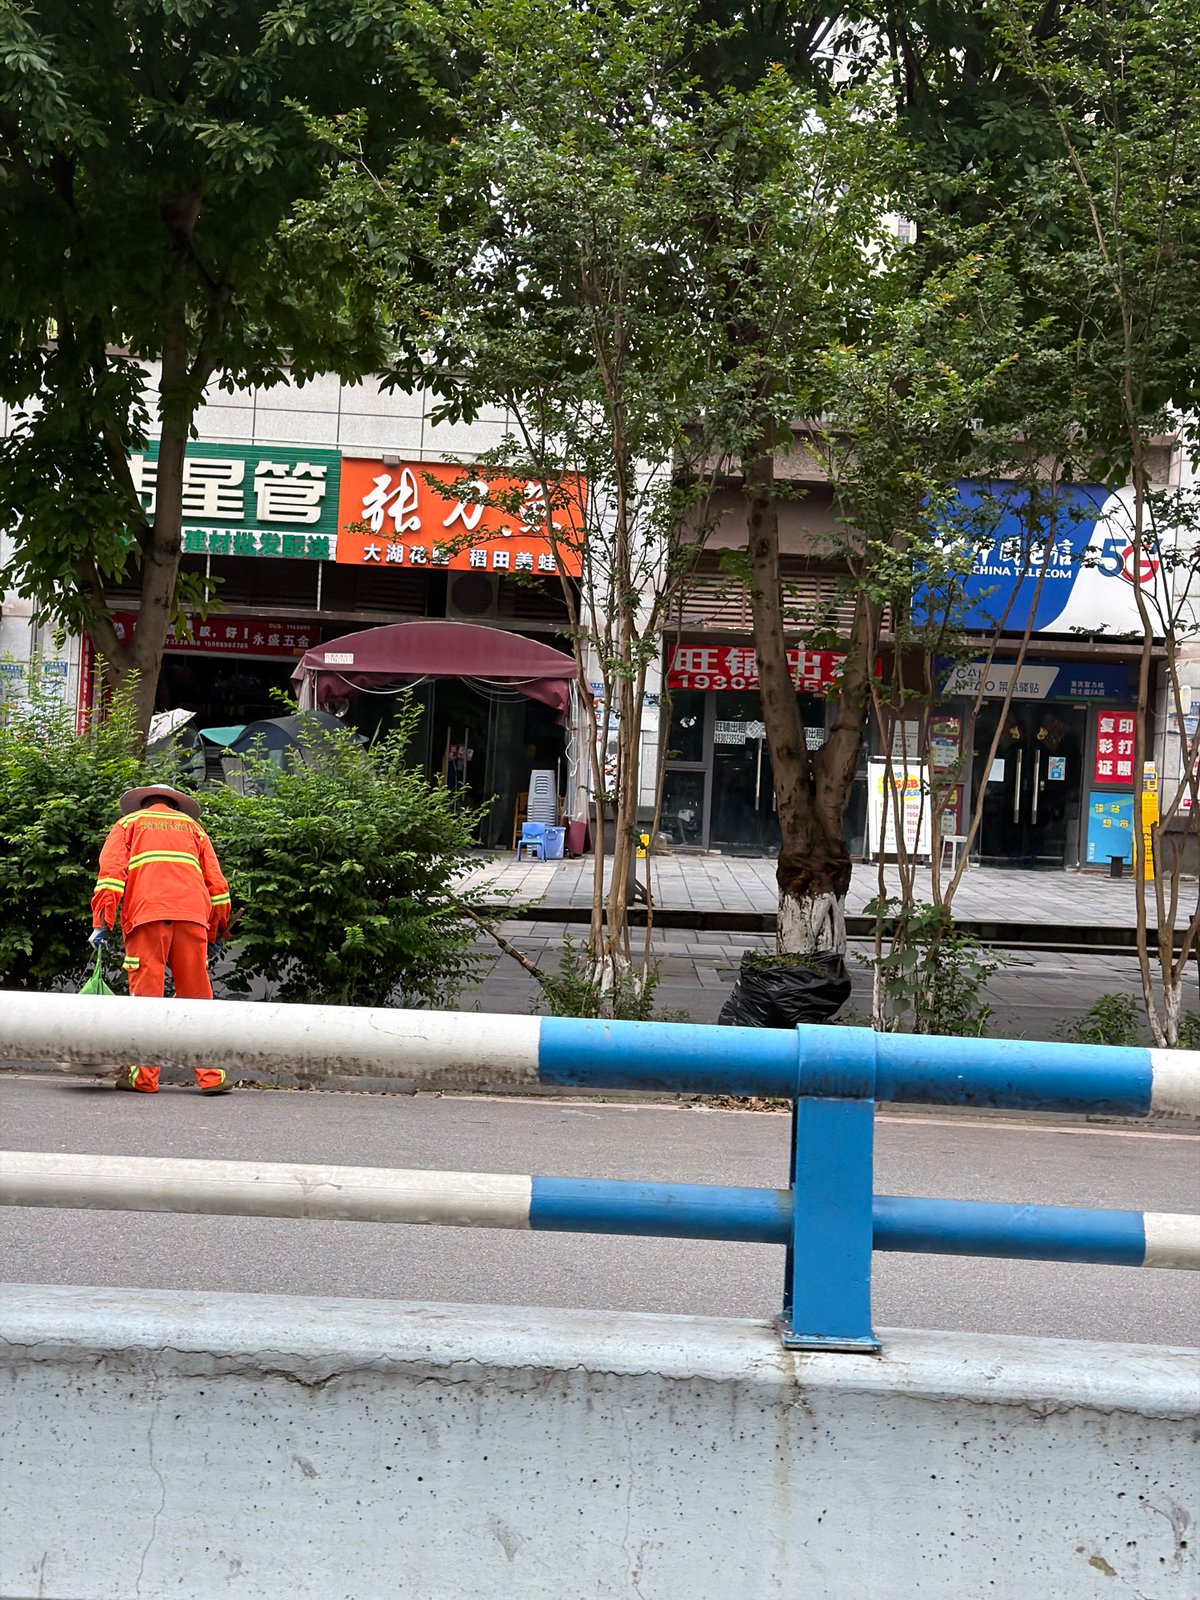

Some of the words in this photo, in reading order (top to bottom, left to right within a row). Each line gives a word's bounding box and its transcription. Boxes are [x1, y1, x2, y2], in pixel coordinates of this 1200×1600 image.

[184, 529, 331, 560] 建材批发配送
[469, 549, 557, 572] 稻田美蛙
[973, 565, 1011, 576] CHINA
[252, 632, 310, 648] 永盛五金
[1100, 717, 1134, 733] 复印
[1099, 738, 1133, 755] 彩打
[1098, 760, 1132, 776] 证照
